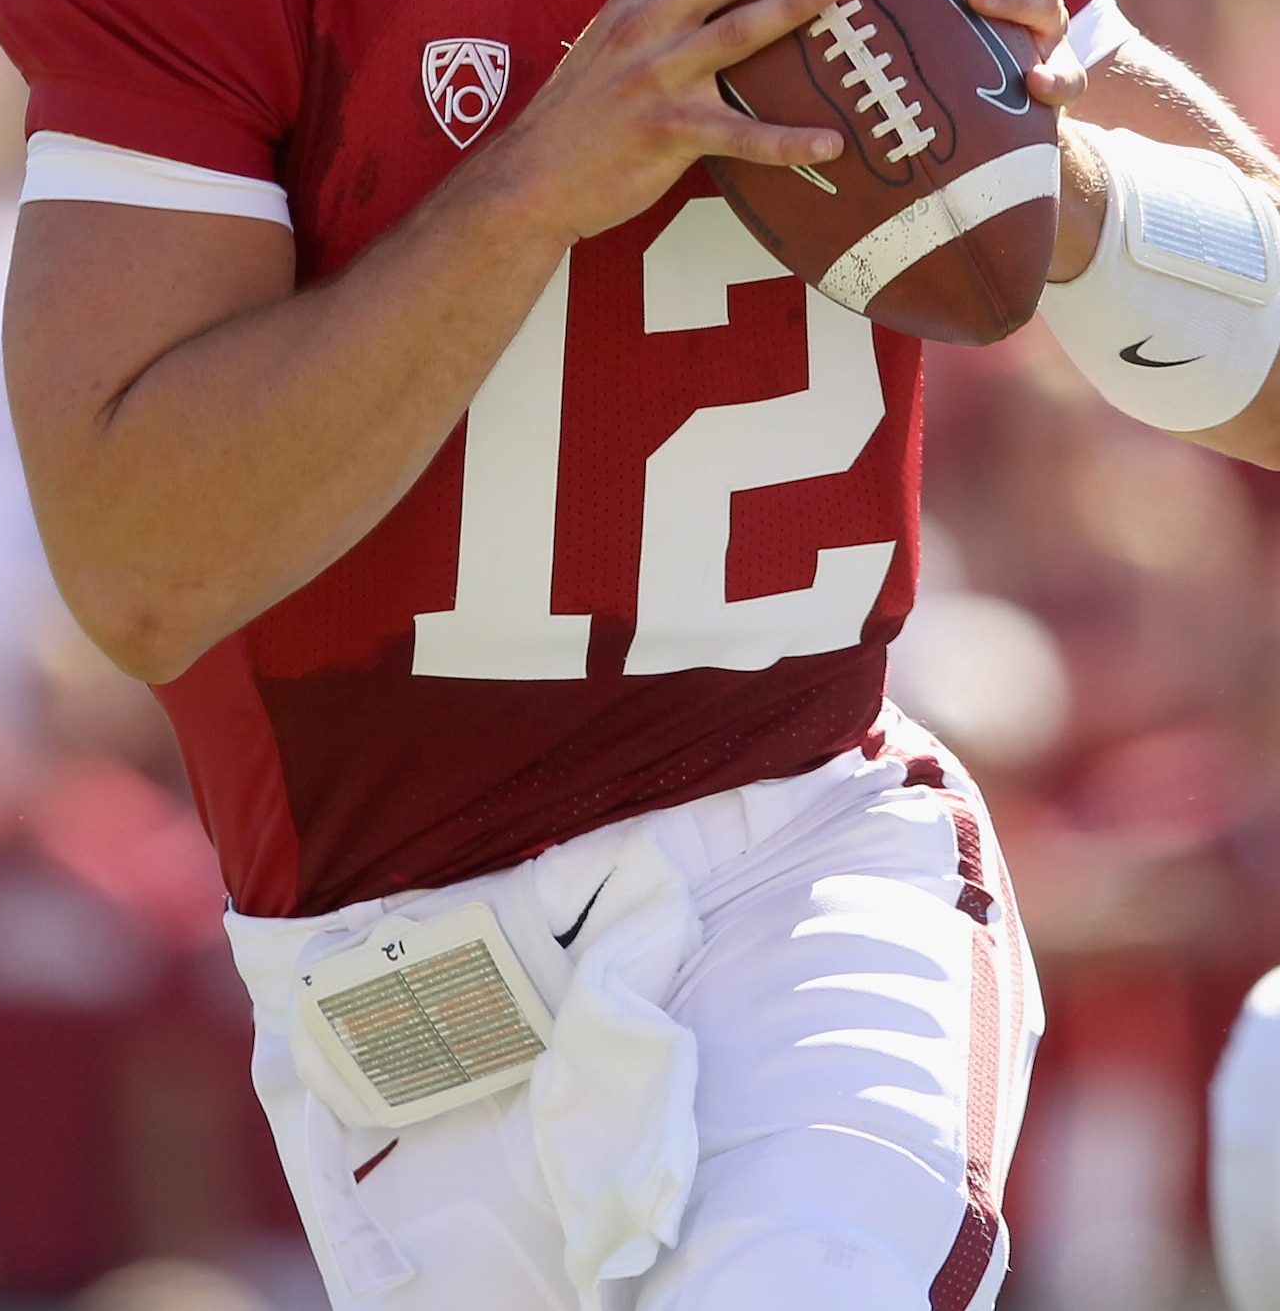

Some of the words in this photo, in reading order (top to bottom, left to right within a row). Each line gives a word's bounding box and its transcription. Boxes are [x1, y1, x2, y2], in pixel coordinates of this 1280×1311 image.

[428, 43, 504, 105] PAC
[445, 85, 489, 124] 10
[411, 196, 897, 680] 12
[381, 940, 405, 961] 12
